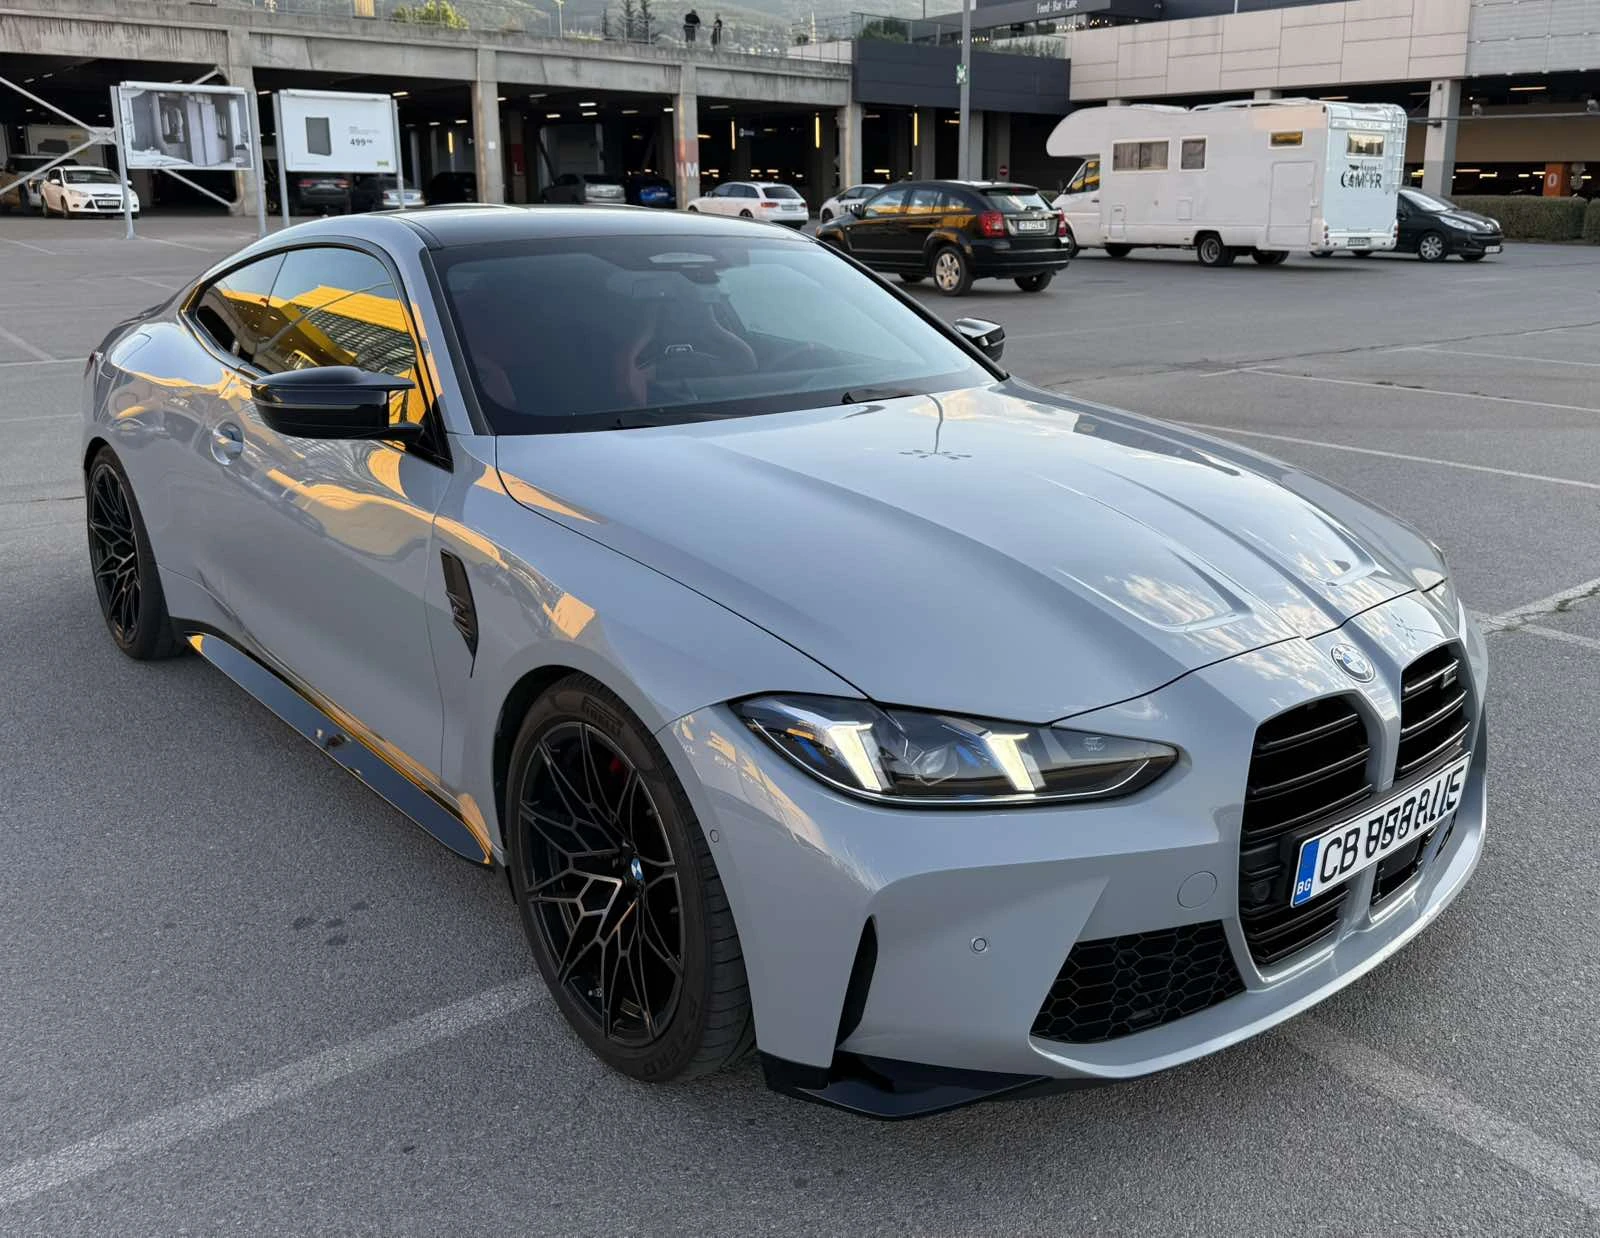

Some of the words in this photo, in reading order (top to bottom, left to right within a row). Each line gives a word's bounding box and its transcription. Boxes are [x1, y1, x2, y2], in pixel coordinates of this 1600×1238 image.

[686, 161, 699, 177] M
[1319, 827, 1361, 884] CB
[1296, 878, 1312, 896] BG
